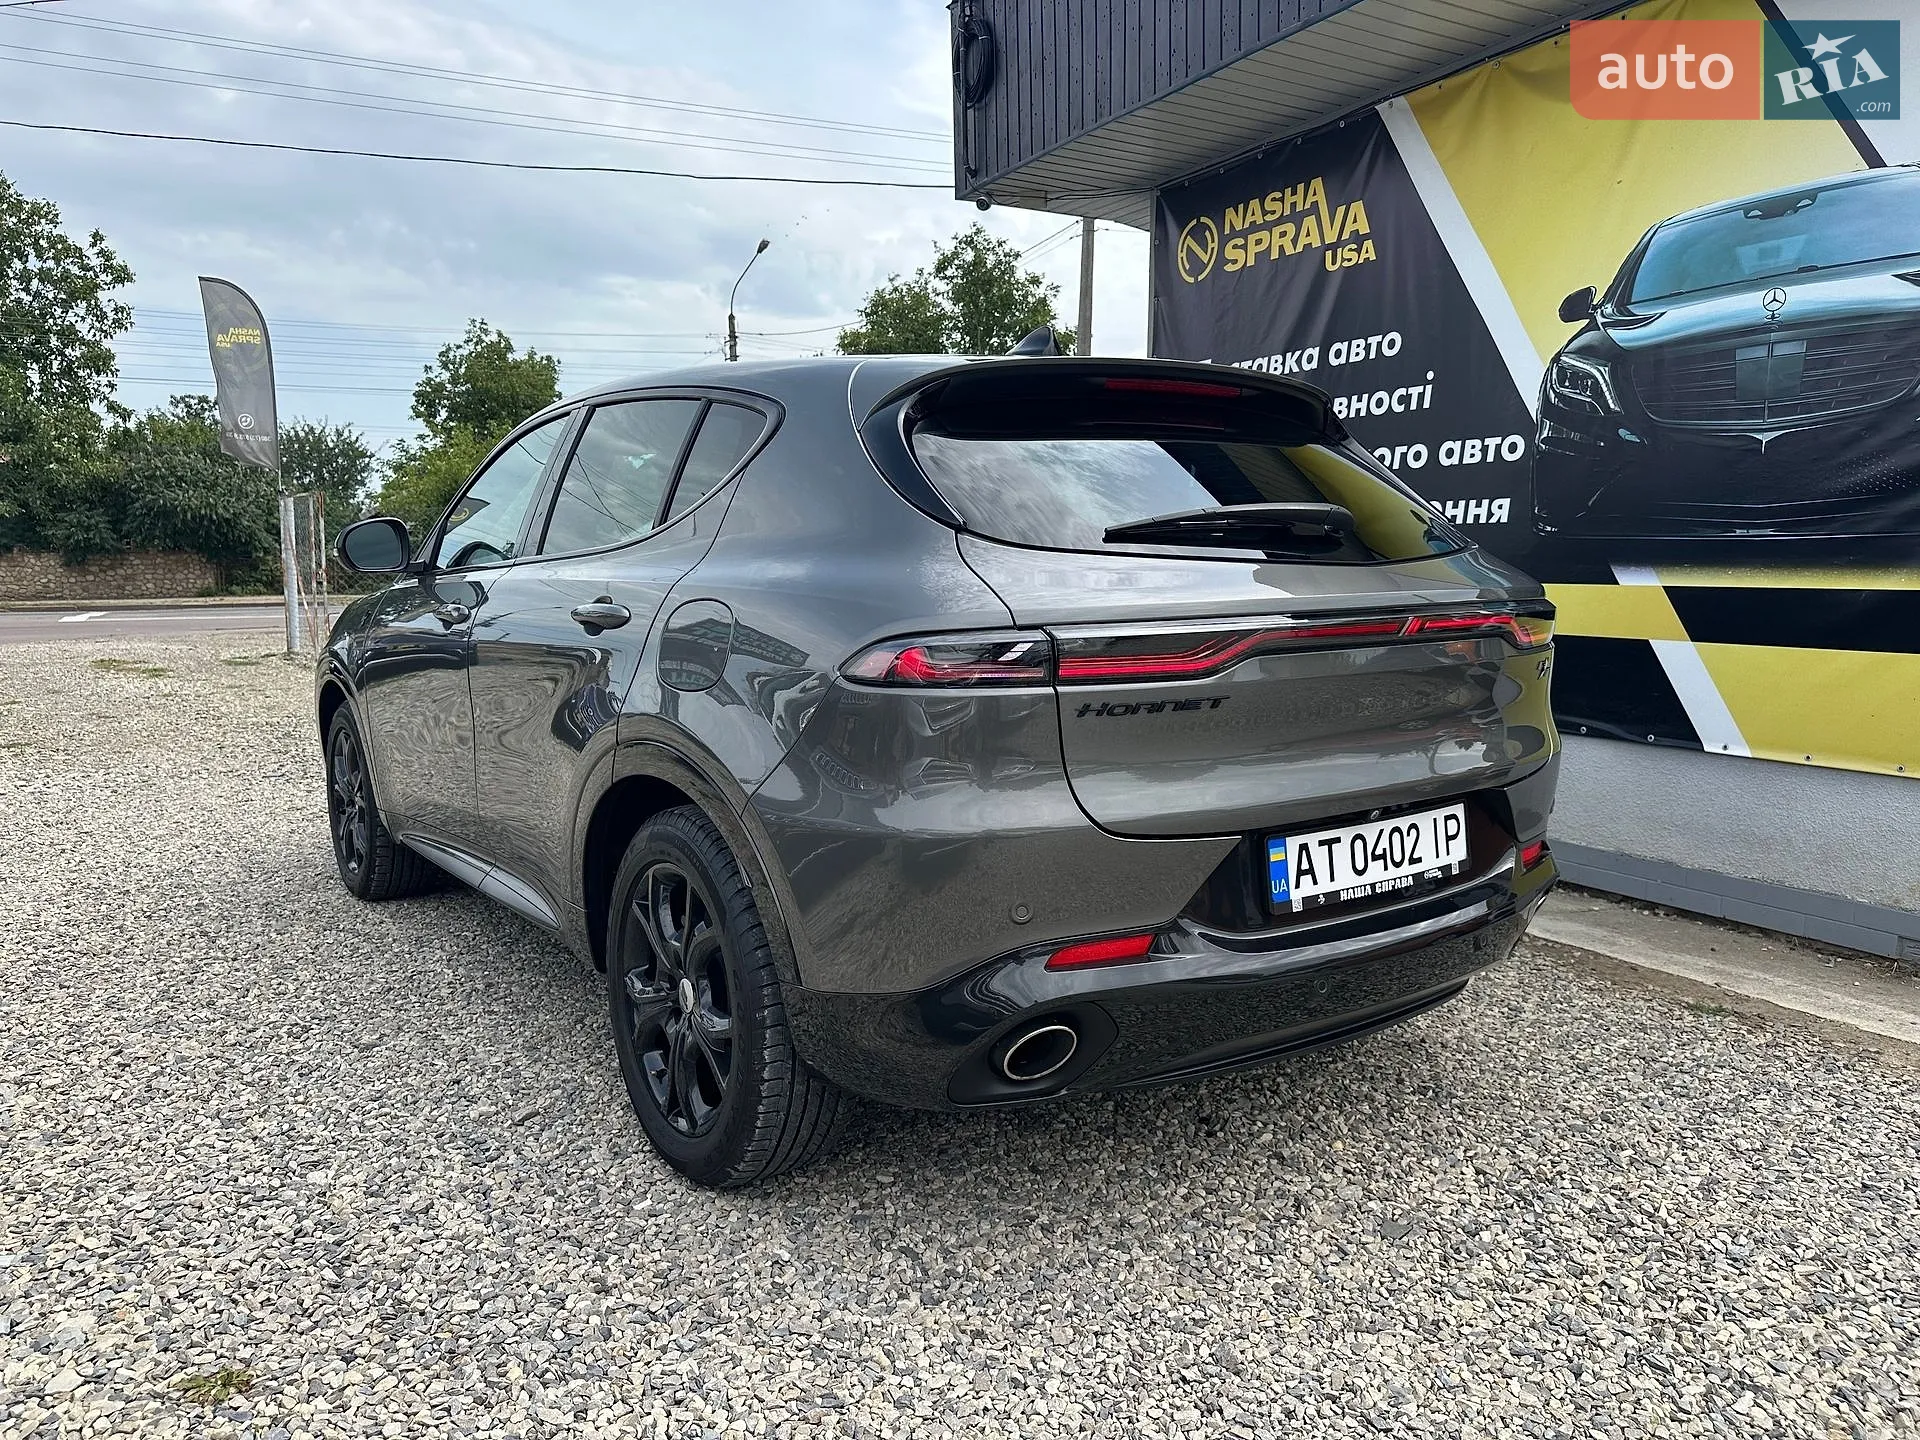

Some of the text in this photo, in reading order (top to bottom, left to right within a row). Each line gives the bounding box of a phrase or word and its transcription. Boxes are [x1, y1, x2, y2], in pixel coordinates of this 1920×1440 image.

[1224, 176, 1325, 235] NASHA
[1223, 200, 1370, 272] SPRAVA
[1325, 239, 1377, 272] USA
[1328, 331, 1403, 367] авто
[1368, 434, 1526, 470] ого авто
[1075, 695, 1232, 718] HORNET
[1294, 813, 1461, 890] AT 0402 IP
[1272, 880, 1288, 894] UA
[1340, 875, 1414, 901] НАША СПРАВА
